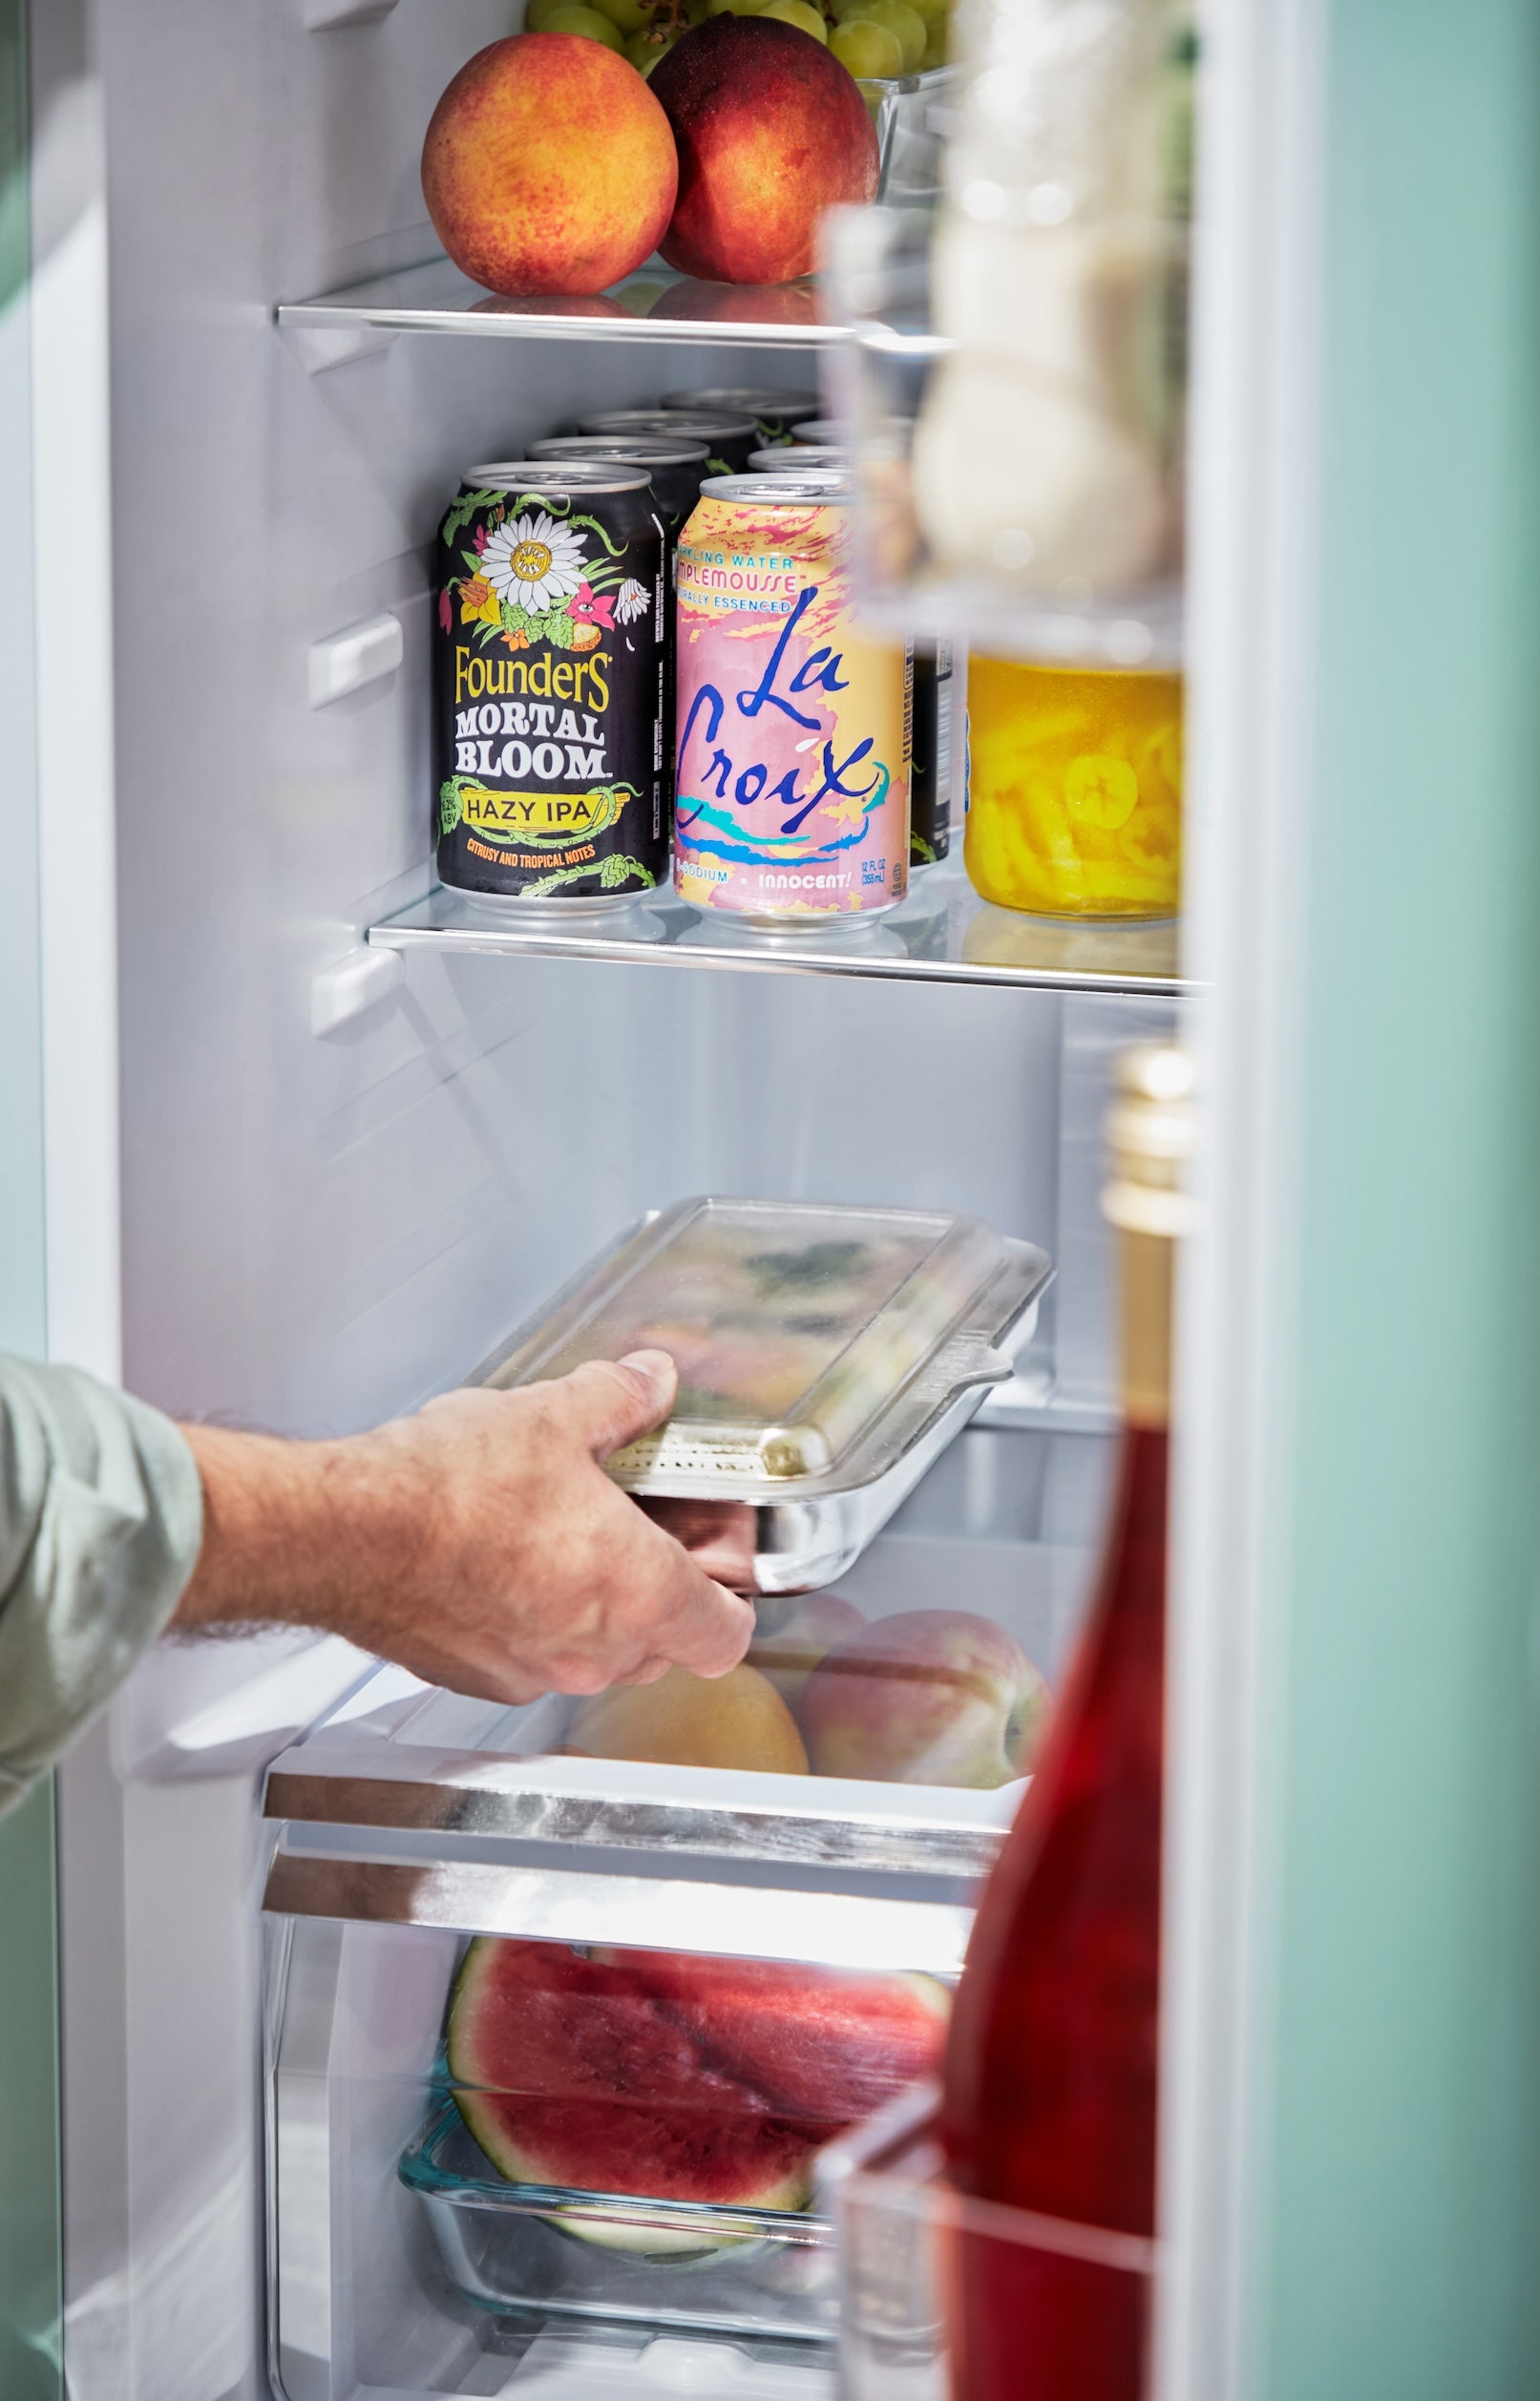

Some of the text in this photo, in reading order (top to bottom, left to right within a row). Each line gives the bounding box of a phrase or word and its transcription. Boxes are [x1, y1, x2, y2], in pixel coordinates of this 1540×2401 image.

[732, 556, 793, 570] WATER
[714, 596, 791, 613] ESSENCED
[736, 586, 850, 730] La
[455, 702, 605, 746] MORTAL
[675, 684, 879, 834] Croix
[444, 812, 456, 824] ABV
[467, 799, 591, 821] HAZY IPA
[466, 837, 596, 869] CITRUSY AND TROPICAL NOTES
